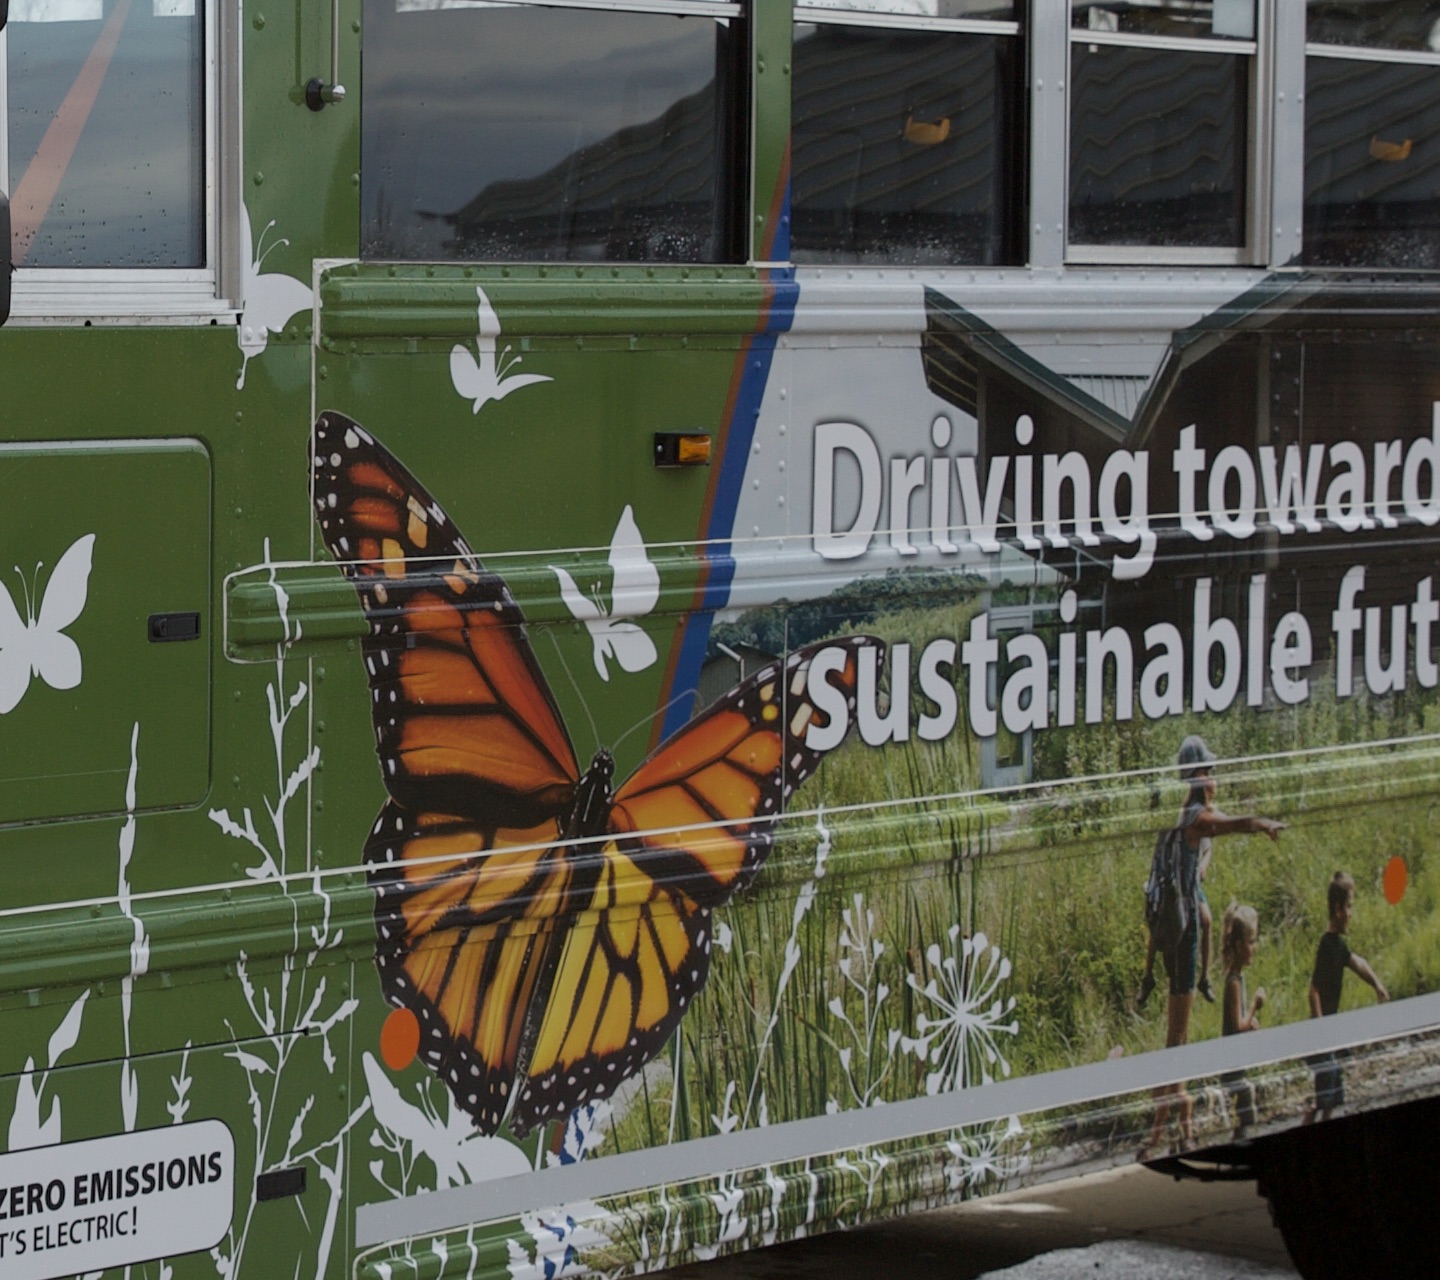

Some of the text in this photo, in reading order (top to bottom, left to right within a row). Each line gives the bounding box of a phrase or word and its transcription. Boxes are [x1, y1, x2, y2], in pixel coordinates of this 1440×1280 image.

[811, 413, 1156, 580] Driving
[804, 572, 1313, 753] sustainable
[32, 1206, 138, 1253] ELECTRIC!
[73, 1150, 223, 1207] EMISSIONS
